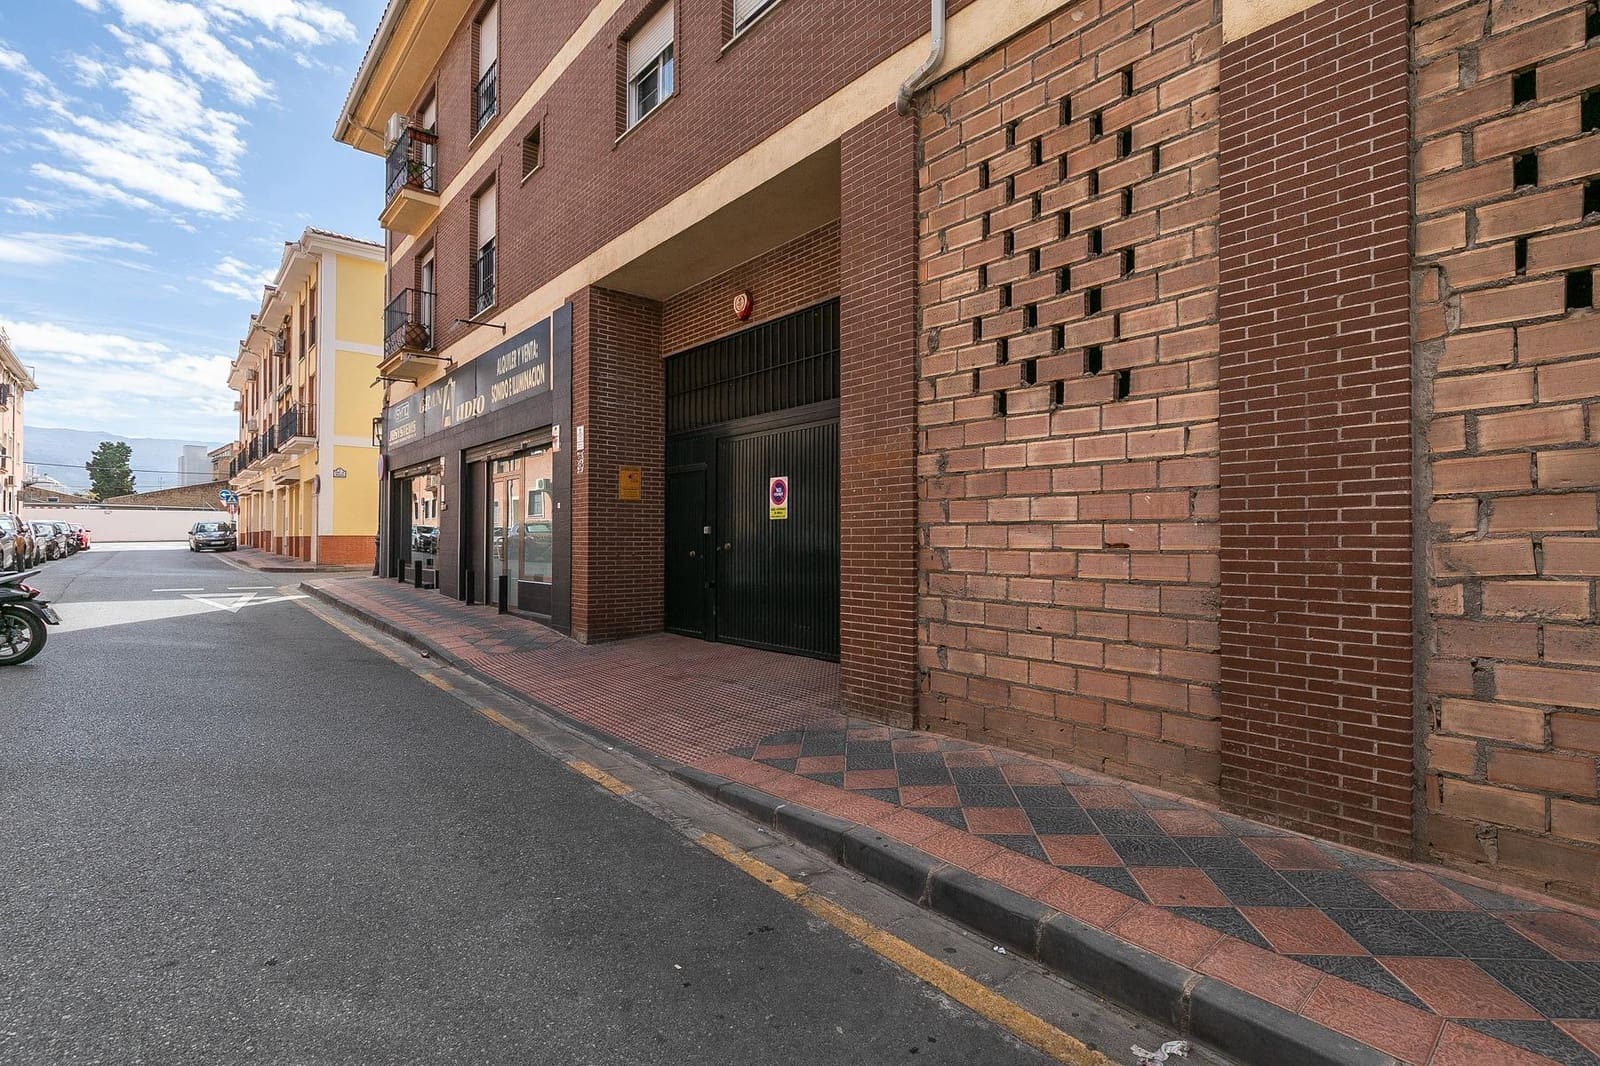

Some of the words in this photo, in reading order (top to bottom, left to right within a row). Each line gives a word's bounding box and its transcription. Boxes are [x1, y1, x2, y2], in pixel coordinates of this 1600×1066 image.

[496, 349, 517, 377] ALQUILER
[419, 387, 444, 414] GRAN
[491, 379, 509, 404] SONIDO
